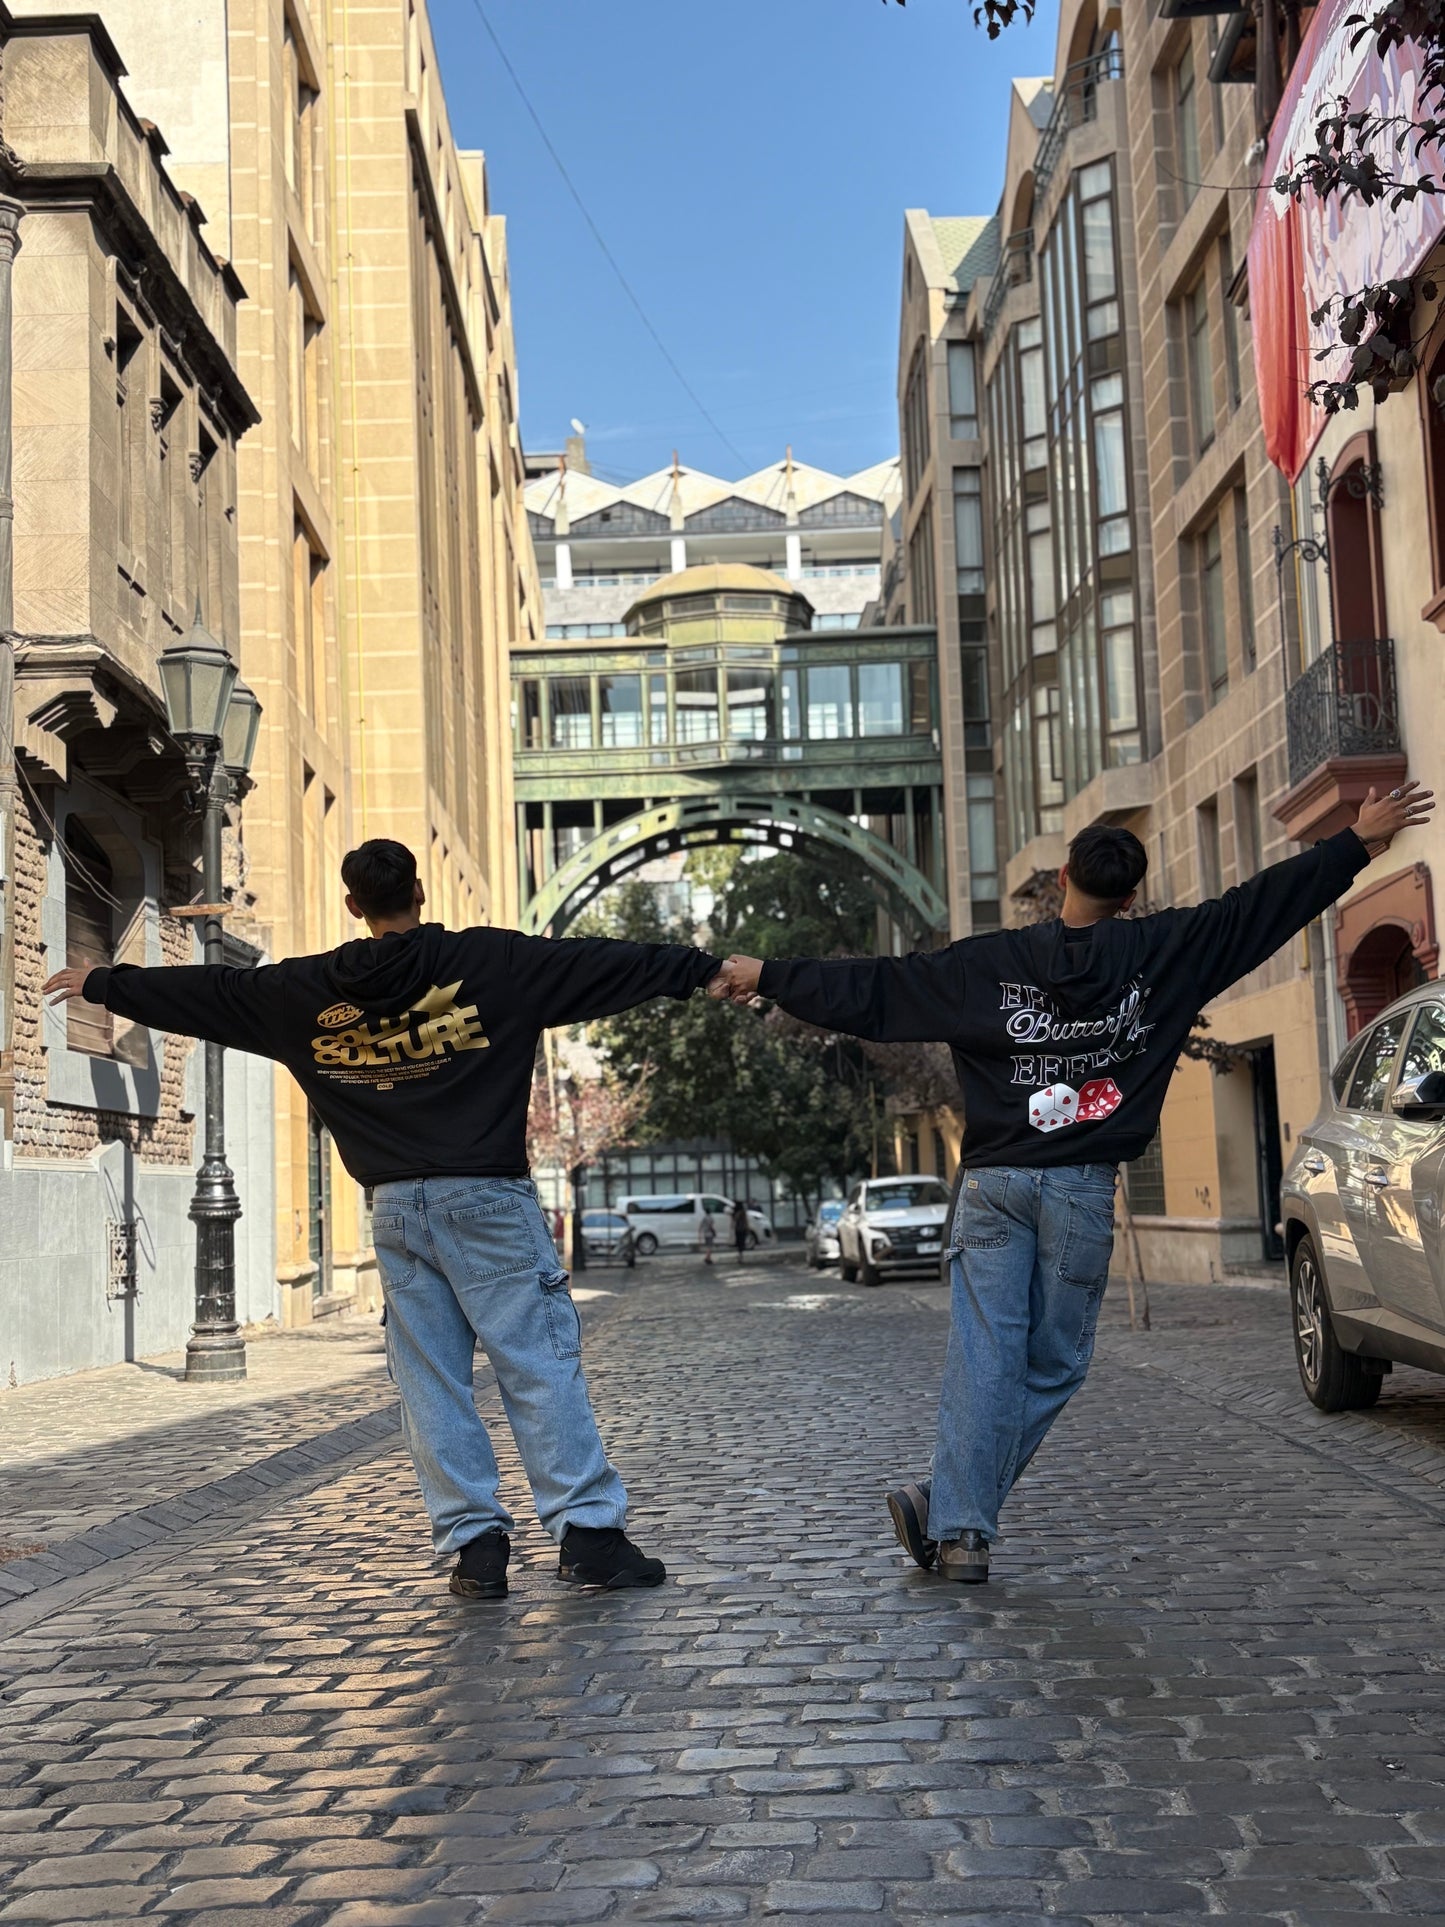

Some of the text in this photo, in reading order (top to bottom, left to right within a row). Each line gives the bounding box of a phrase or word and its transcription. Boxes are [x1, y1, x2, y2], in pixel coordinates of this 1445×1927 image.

[311, 1012, 410, 1051] COLD
[313, 1004, 491, 1066] CULTURE
[324, 1008, 361, 1026] LUCK
[1006, 990, 1147, 1051] Butterfly
